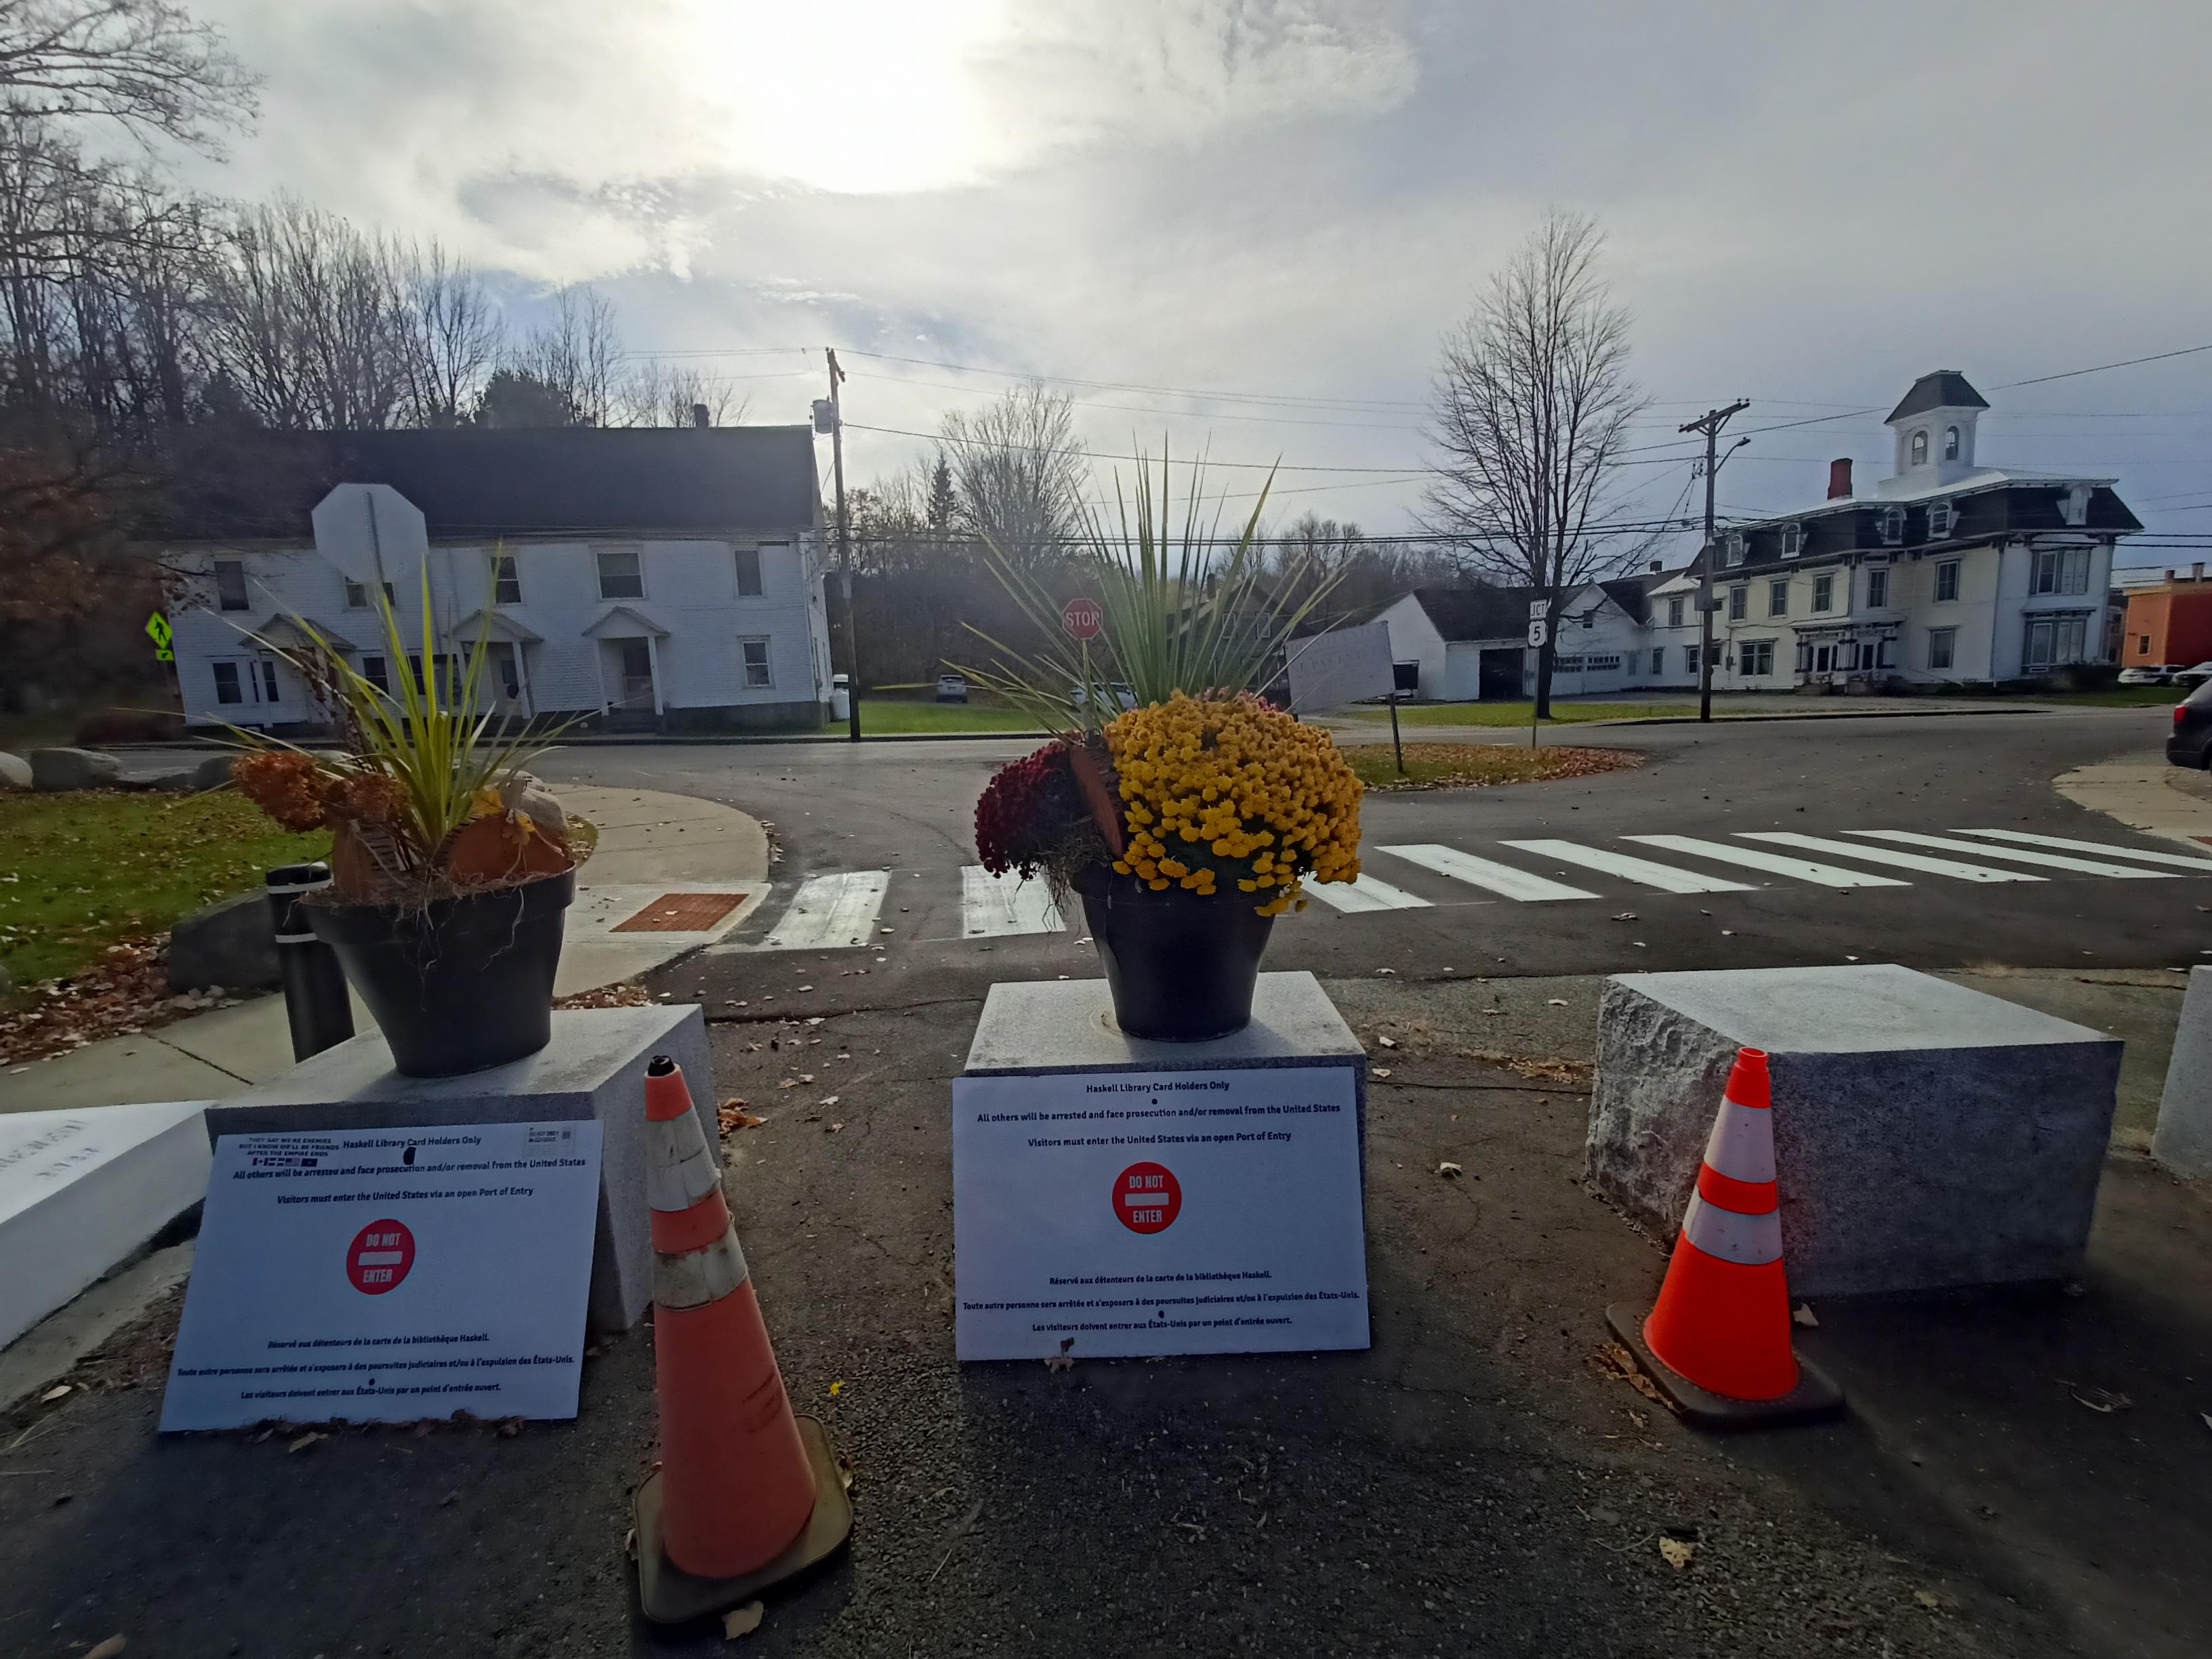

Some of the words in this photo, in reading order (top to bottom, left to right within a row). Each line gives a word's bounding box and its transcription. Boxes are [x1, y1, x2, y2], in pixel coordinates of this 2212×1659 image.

[1531, 603, 1545, 616] JCT
[1066, 611, 1100, 627] STOP
[1534, 626, 1540, 641] 5
[1086, 1084, 1118, 1093] Haskell
[1120, 1084, 1151, 1093] Library
[1153, 1082, 1173, 1091] Card
[1175, 1082, 1208, 1090] Holders
[1210, 1081, 1229, 1091] Only
[977, 1113, 990, 1122] All
[991, 1113, 1019, 1122] others
[1021, 1112, 1038, 1121] will
[1039, 1112, 1050, 1120] be
[1051, 1111, 1086, 1120] arrested
[1088, 1109, 1104, 1119] and
[1106, 1109, 1124, 1118] face
[1126, 1109, 1176, 1120] prosecution
[1178, 1107, 1207, 1117] and/or
[1208, 1106, 1243, 1115] removal
[1244, 1106, 1265, 1115] from
[1267, 1105, 1281, 1114] the
[1283, 1105, 1311, 1113] United
[1313, 1104, 1340, 1113] States
[343, 1140, 374, 1149] Haskell
[375, 1139, 406, 1149] Library
[407, 1137, 426, 1146] Card
[427, 1136, 460, 1145] Holders
[462, 1136, 481, 1145] Only
[1028, 1139, 1061, 1147] Visitors
[1063, 1138, 1084, 1146] must
[1086, 1137, 1109, 1145] enter
[1111, 1136, 1125, 1144] the
[1127, 1134, 1155, 1144] United
[1158, 1134, 1185, 1143] States
[1186, 1134, 1200, 1143] via
[1213, 1134, 1234, 1143] open
[1236, 1132, 1255, 1141] Port
[1256, 1131, 1266, 1141] of
[1267, 1132, 1291, 1141] Entry
[233, 1170, 246, 1179] All
[247, 1170, 274, 1179] others
[275, 1168, 291, 1177] will
[340, 1167, 356, 1175] and
[357, 1166, 375, 1174] face
[376, 1164, 425, 1175] prosecution
[427, 1162, 455, 1172] and/or
[457, 1161, 490, 1170] removal
[492, 1161, 512, 1169] from
[514, 1160, 527, 1168] the
[529, 1159, 558, 1168] United
[558, 1158, 586, 1166] States
[1129, 1176, 1142, 1189] DO
[1145, 1175, 1164, 1188] NOT
[278, 1195, 309, 1204] Visitors
[310, 1194, 332, 1202] must
[357, 1192, 371, 1201] the
[373, 1191, 401, 1200] United
[402, 1191, 428, 1199] States
[430, 1189, 443, 1198] via
[457, 1191, 477, 1200] open
[479, 1188, 497, 1196] Port
[499, 1187, 509, 1195] of
[510, 1187, 533, 1196] Entry
[1132, 1210, 1162, 1223] ENTER
[366, 1233, 380, 1248] DO
[381, 1233, 401, 1246] NOT
[363, 1269, 392, 1283] ENTER
[1050, 1276, 1079, 1285] Réservé
[1094, 1275, 1134, 1284] détenteurs
[1194, 1271, 1241, 1282] bibliothèque
[1242, 1271, 1272, 1279] Haskell.
[1006, 1303, 1040, 1311] personne
[1058, 1299, 1085, 1307] arrêtée
[1095, 1298, 1134, 1309] s'exposera
[1155, 1296, 1195, 1307] poursuites
[1195, 1295, 1235, 1305] judiciaires
[1235, 1294, 1256, 1303] et/ou
[1263, 1293, 1303, 1303] l'expulsion
[1305, 1292, 1317, 1300] des
[1319, 1291, 1360, 1299] États-Unis.
[1046, 1323, 1078, 1331] visiteurs
[1148, 1319, 1187, 1328] États-Unis
[1188, 1321, 1201, 1329] par
[1213, 1318, 1233, 1328] point
[1233, 1317, 1264, 1326] d'entrée
